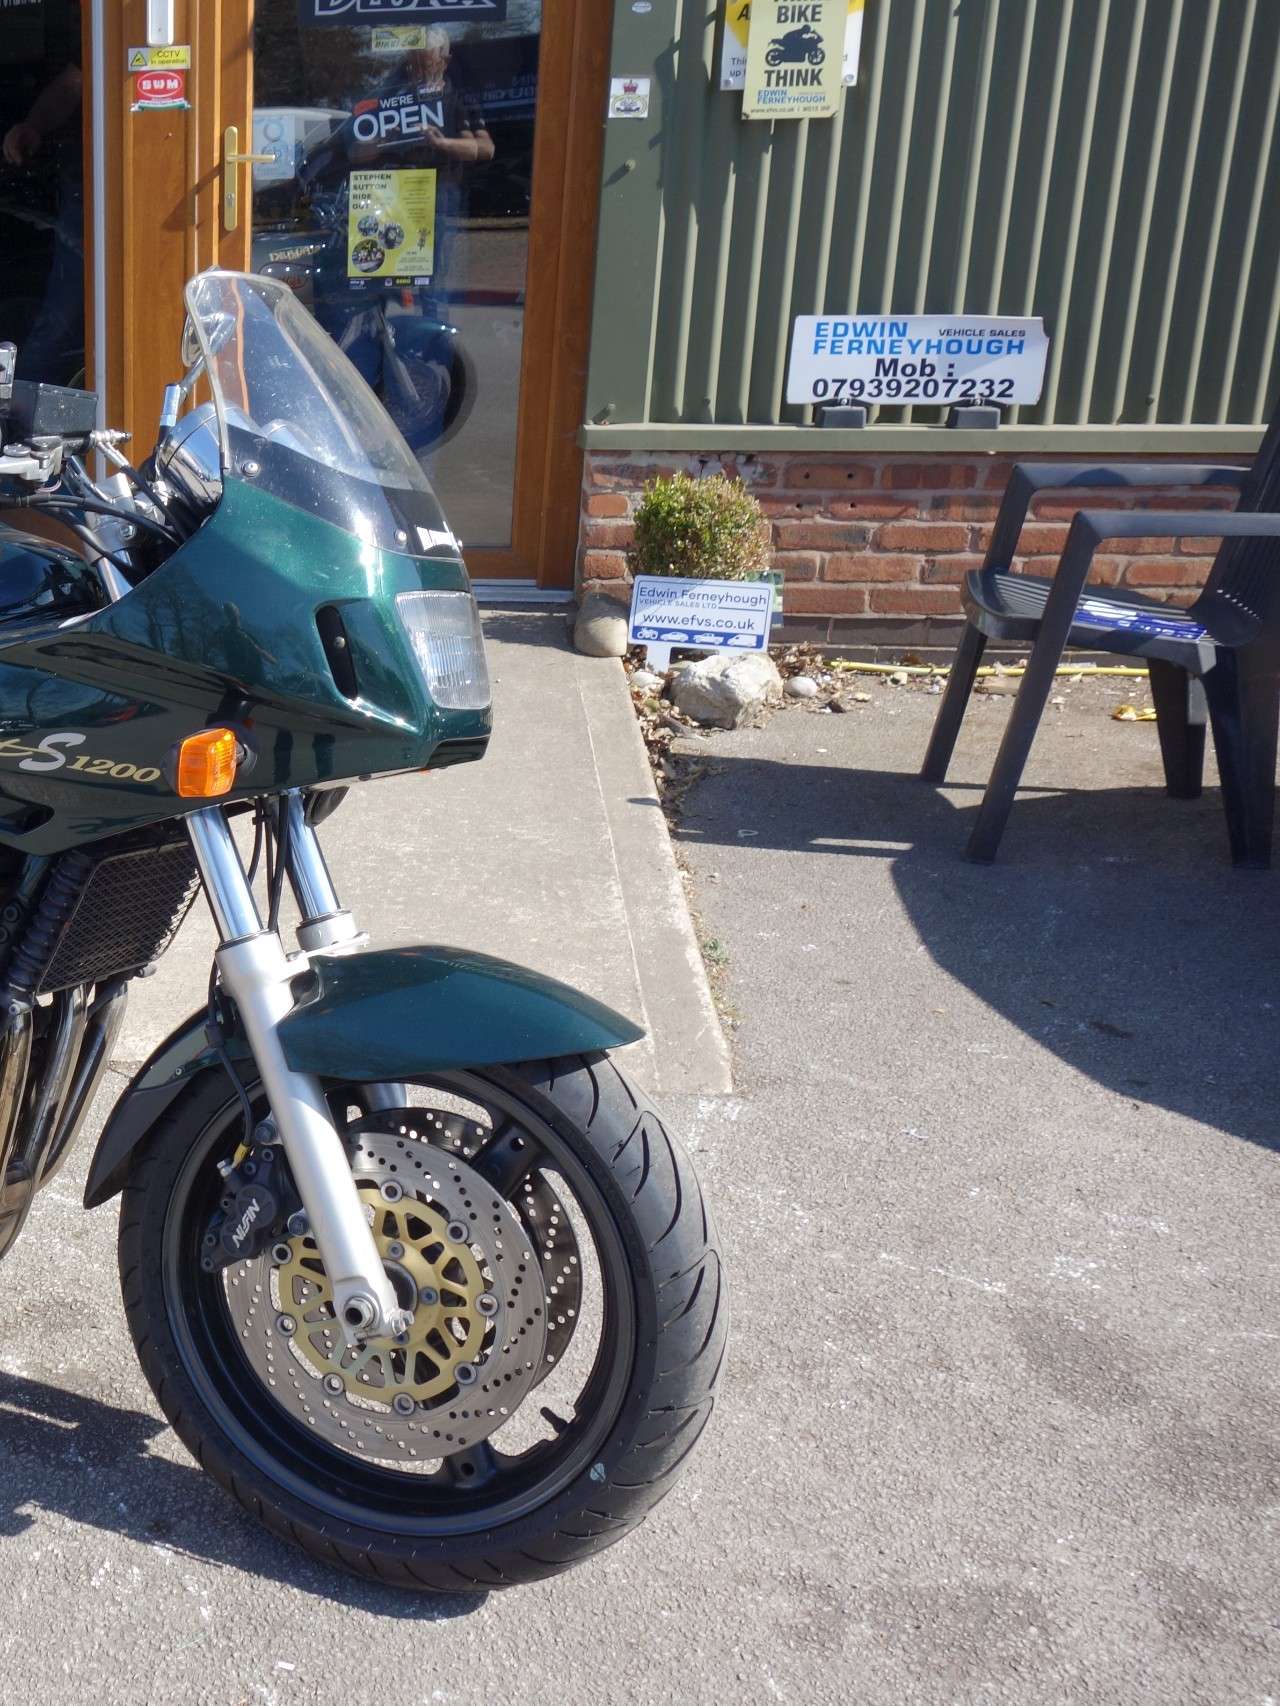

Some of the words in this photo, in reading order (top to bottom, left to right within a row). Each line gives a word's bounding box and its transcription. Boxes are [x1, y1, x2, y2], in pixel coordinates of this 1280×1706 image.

[776, 4, 823, 24] BIKE
[763, 68, 824, 88] THINK
[379, 95, 414, 109] WE'RE
[756, 95, 826, 105] FERNEYHOUGH
[757, 89, 788, 97] EDWIN
[353, 101, 445, 142] OPEN
[815, 322, 908, 338] EDWIN
[938, 329, 985, 337] VEHICLE
[989, 329, 1026, 337] SALES
[813, 339, 1025, 355] FERNEYHOUGH
[874, 358, 936, 378] Mob
[812, 379, 1015, 399] 07939207232
[639, 586, 678, 599] Edwin
[681, 588, 767, 607] Ferneyhough
[643, 613, 755, 631] www.efvs.co.uk
[66, 755, 162, 783] 1200
